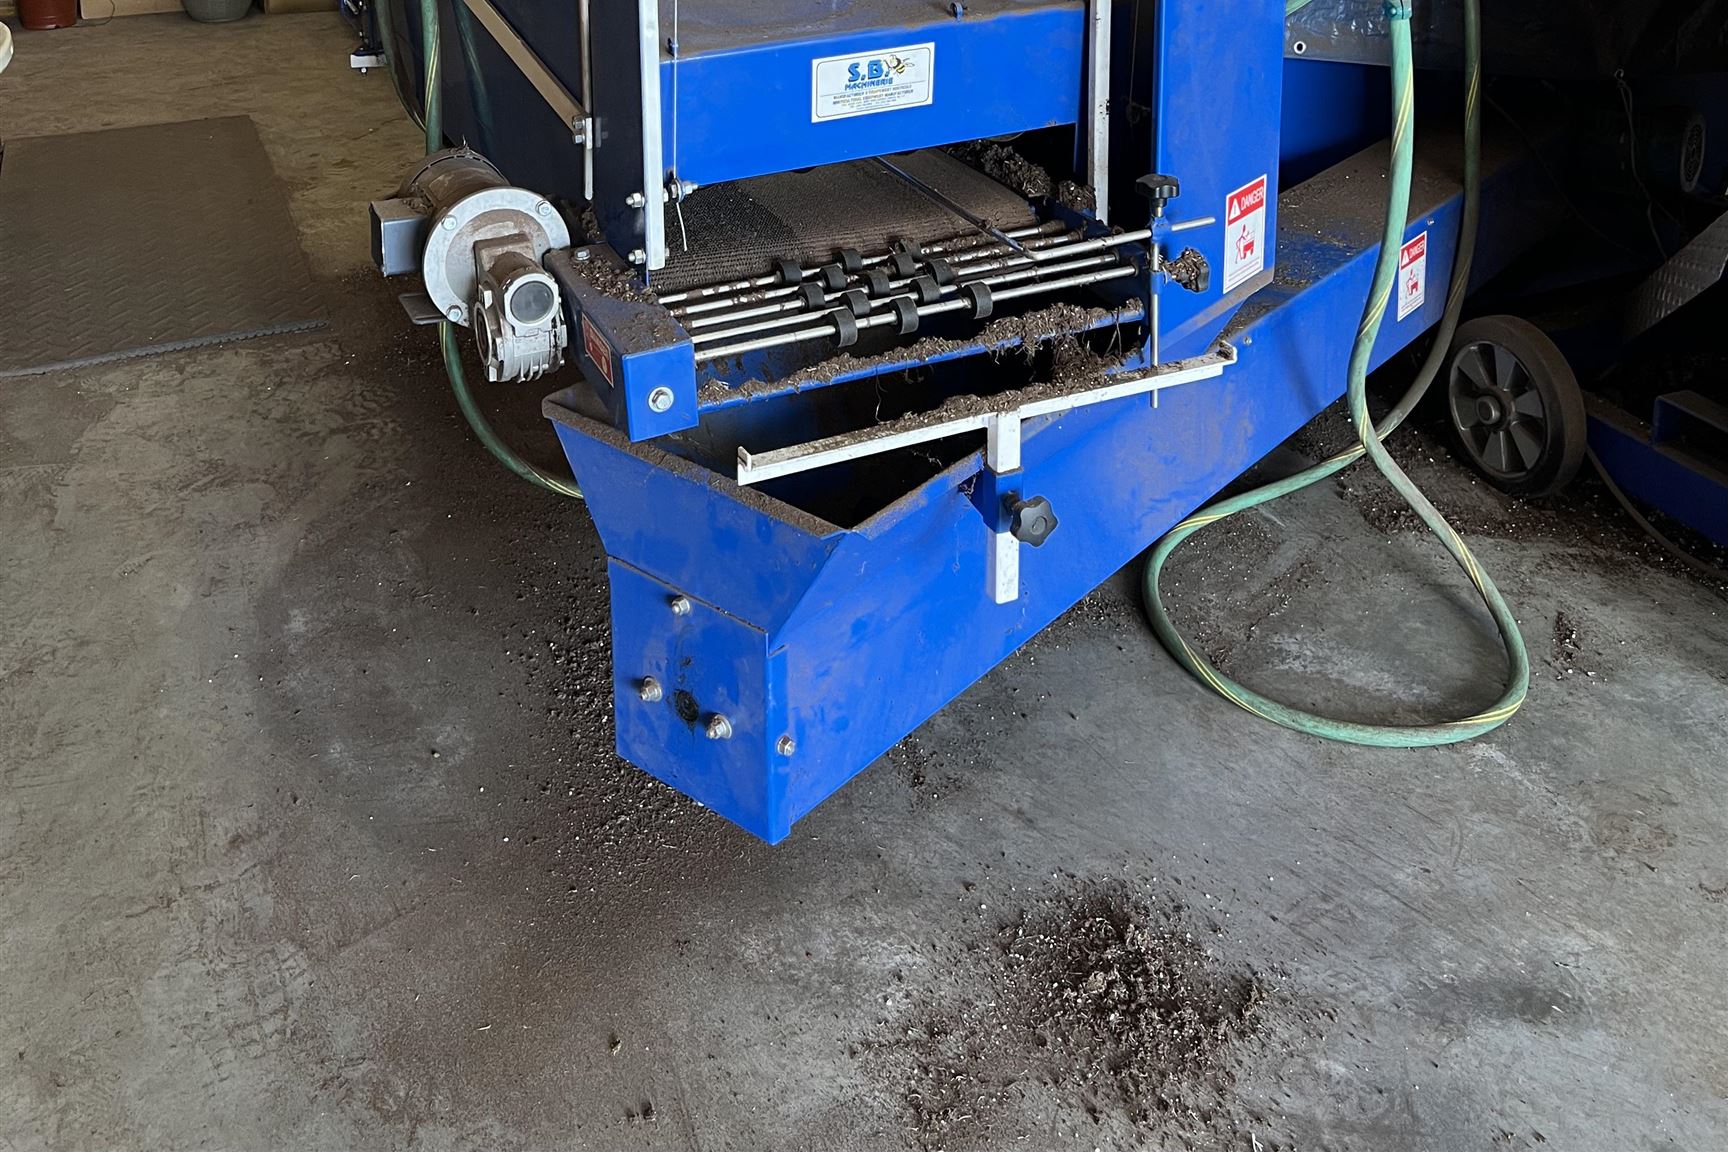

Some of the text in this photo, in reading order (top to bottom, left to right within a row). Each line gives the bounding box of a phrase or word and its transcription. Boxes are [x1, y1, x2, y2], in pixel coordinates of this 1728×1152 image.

[848, 59, 890, 83] S.B.
[844, 77, 894, 91] MACHINERIE
[1240, 186, 1264, 211] DANGER
